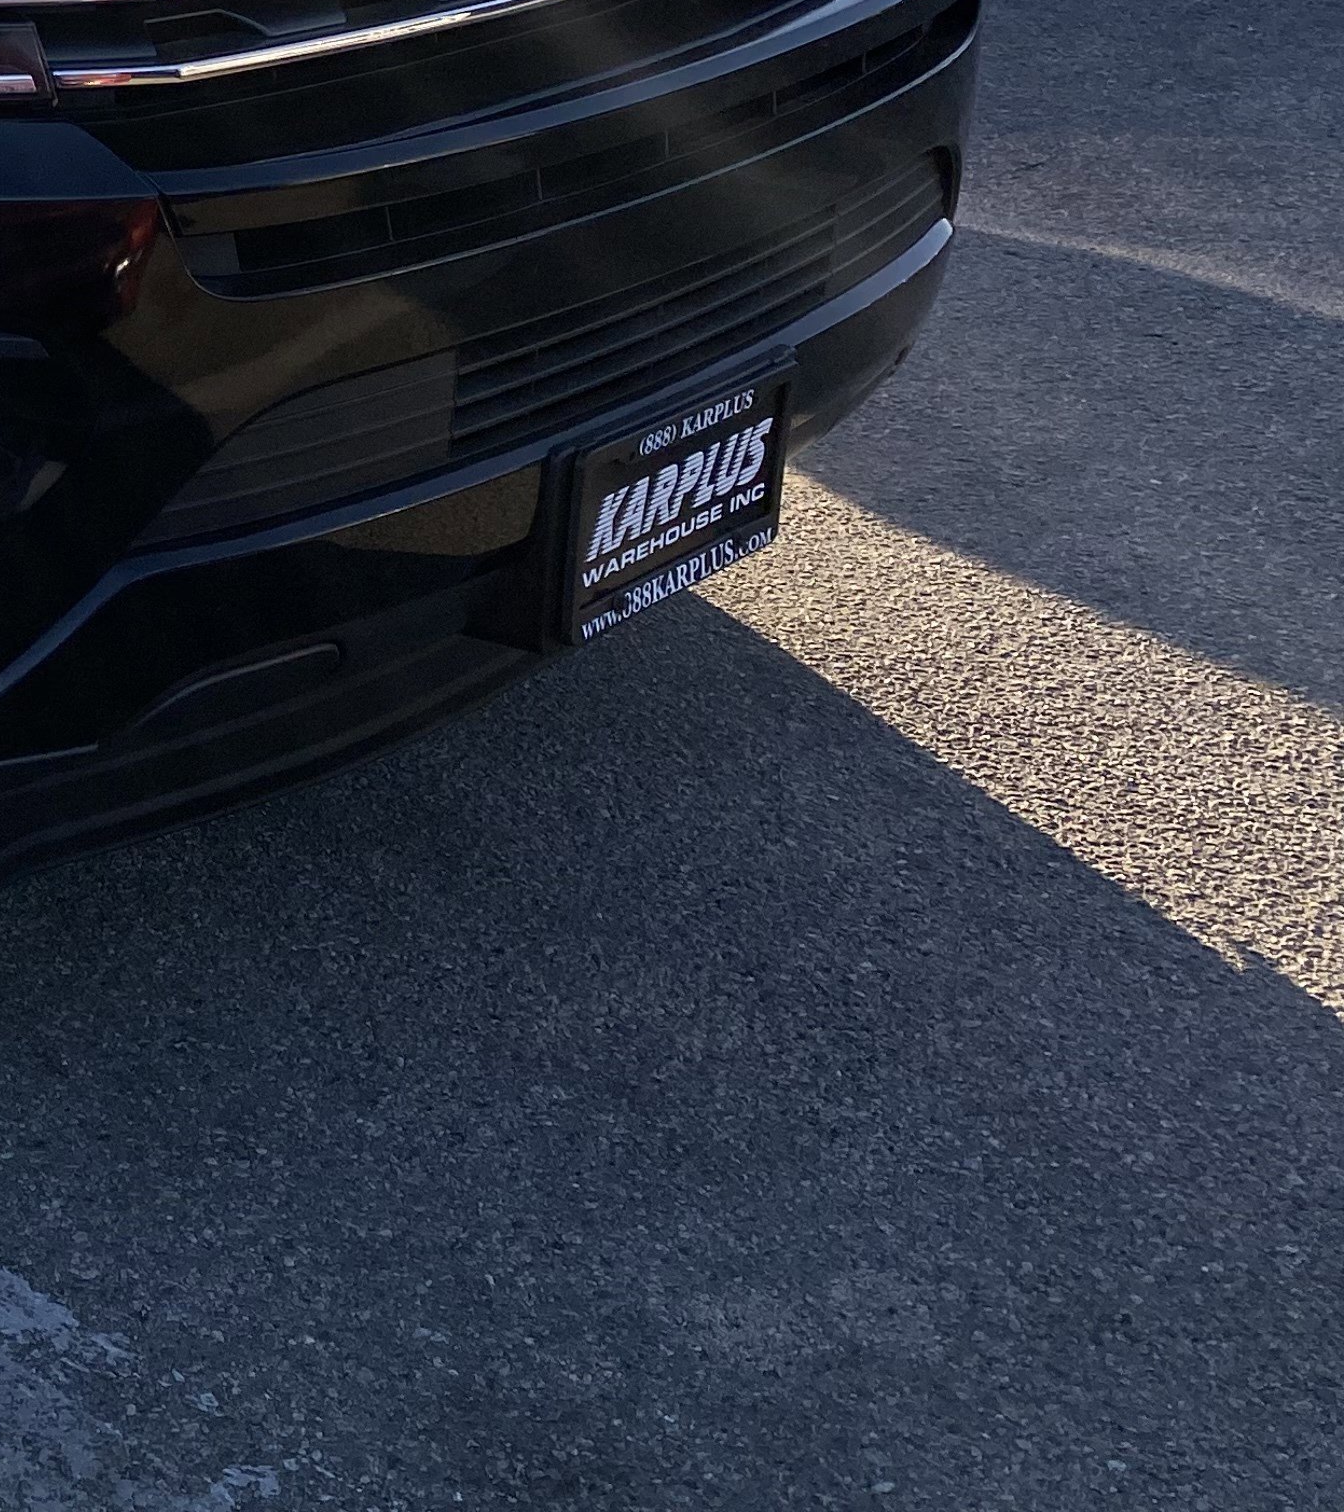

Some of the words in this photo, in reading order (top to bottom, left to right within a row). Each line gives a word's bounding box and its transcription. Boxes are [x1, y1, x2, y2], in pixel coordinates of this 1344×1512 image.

[639, 423, 677, 456] (888)
[680, 389, 755, 439] KARPLUS
[582, 503, 723, 589] WAREHOUSE
[730, 483, 765, 513] INC
[585, 417, 774, 563] KARPLUS
